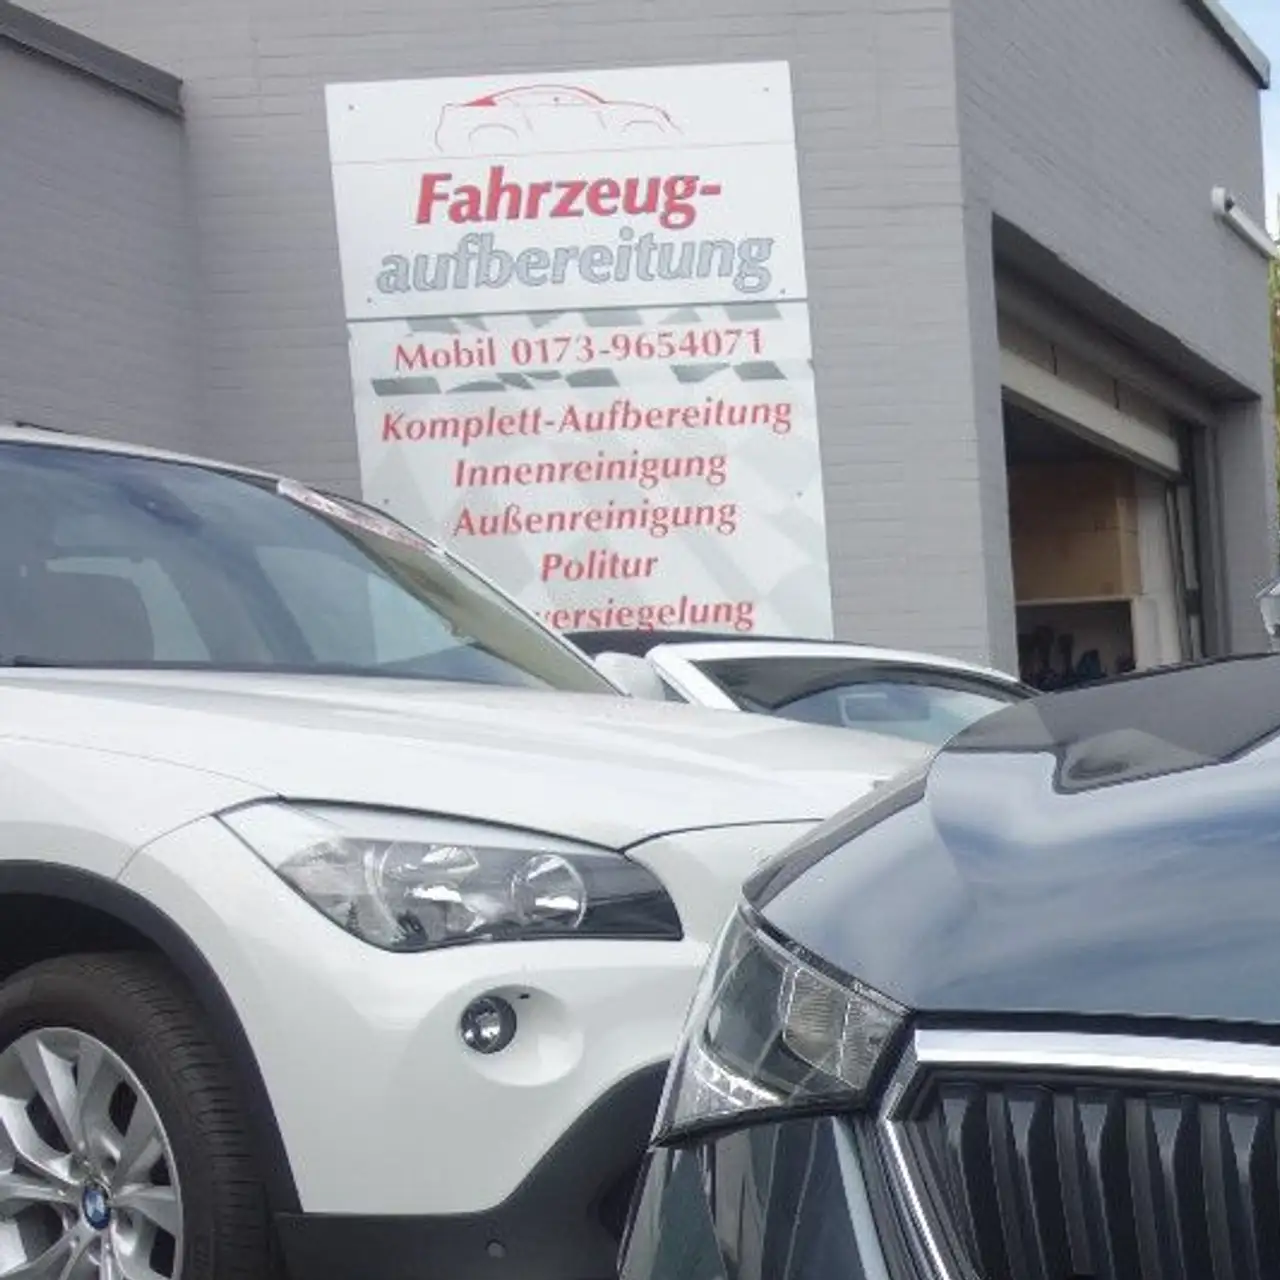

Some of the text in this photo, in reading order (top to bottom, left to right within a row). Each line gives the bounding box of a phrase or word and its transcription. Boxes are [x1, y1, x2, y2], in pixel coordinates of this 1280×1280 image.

[415, 166, 722, 230] Fahrzeug-
[376, 225, 775, 295] aufbereitung
[394, 327, 764, 371] Mobil 0173-9654071
[382, 396, 793, 446] Komplett-Aufbereitung
[454, 449, 728, 489] Innenreinigung
[453, 499, 737, 538] Außenreinigung
[541, 550, 659, 583] Politur
